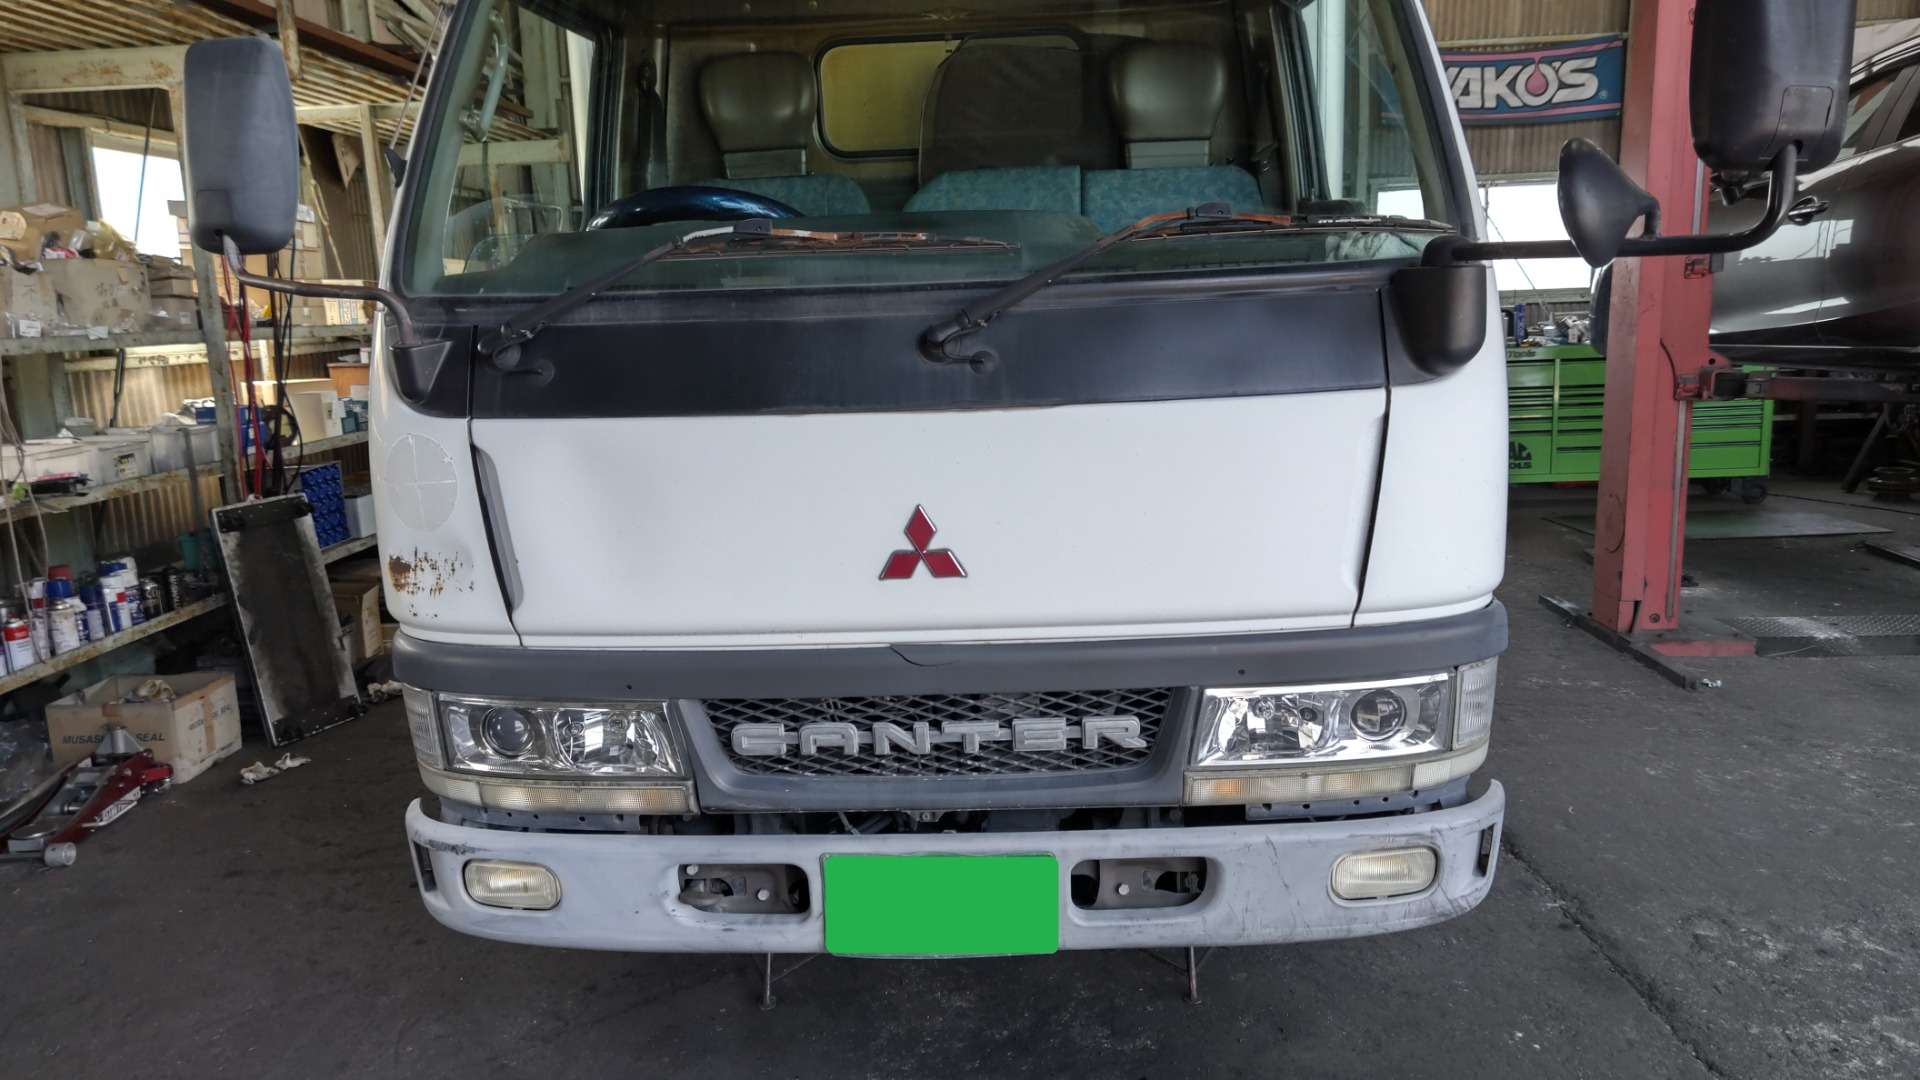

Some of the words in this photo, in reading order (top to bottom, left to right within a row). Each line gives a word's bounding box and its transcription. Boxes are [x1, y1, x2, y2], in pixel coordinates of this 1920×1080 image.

[1446, 56, 1599, 108] AKO'S
[136, 732, 165, 742] SEAL
[731, 715, 1148, 756] CANTER
